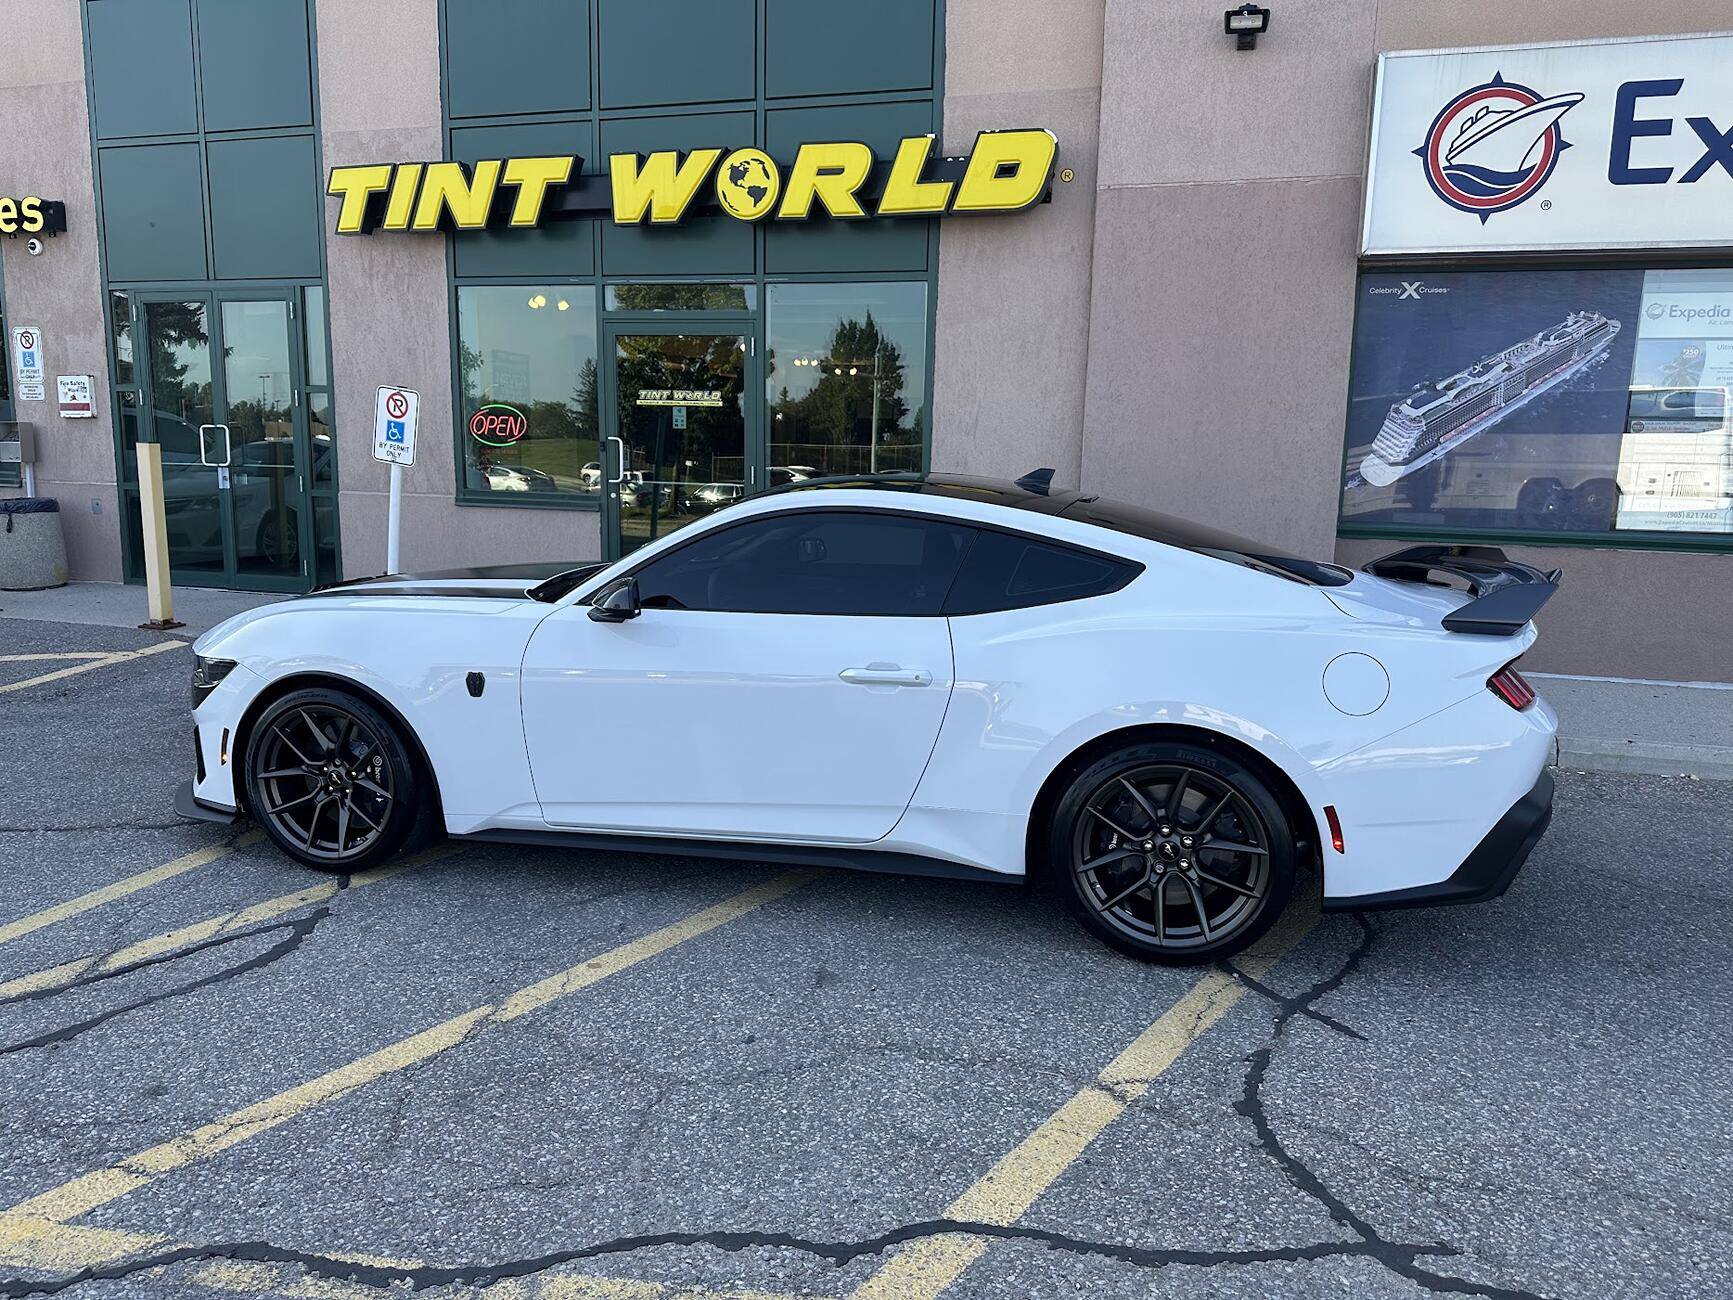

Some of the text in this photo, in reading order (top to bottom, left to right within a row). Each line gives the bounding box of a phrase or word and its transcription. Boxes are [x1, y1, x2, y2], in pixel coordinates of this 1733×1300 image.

[327, 127, 1059, 233] TINT WORLD
[0, 196, 45, 233] es
[1369, 281, 1447, 300] Celebrity X Cruises
[1669, 305, 1730, 321] Expedia
[639, 390, 721, 401] TINT WORLD
[473, 415, 521, 436] OPEN
[379, 441, 410, 454] BY PERMIT
